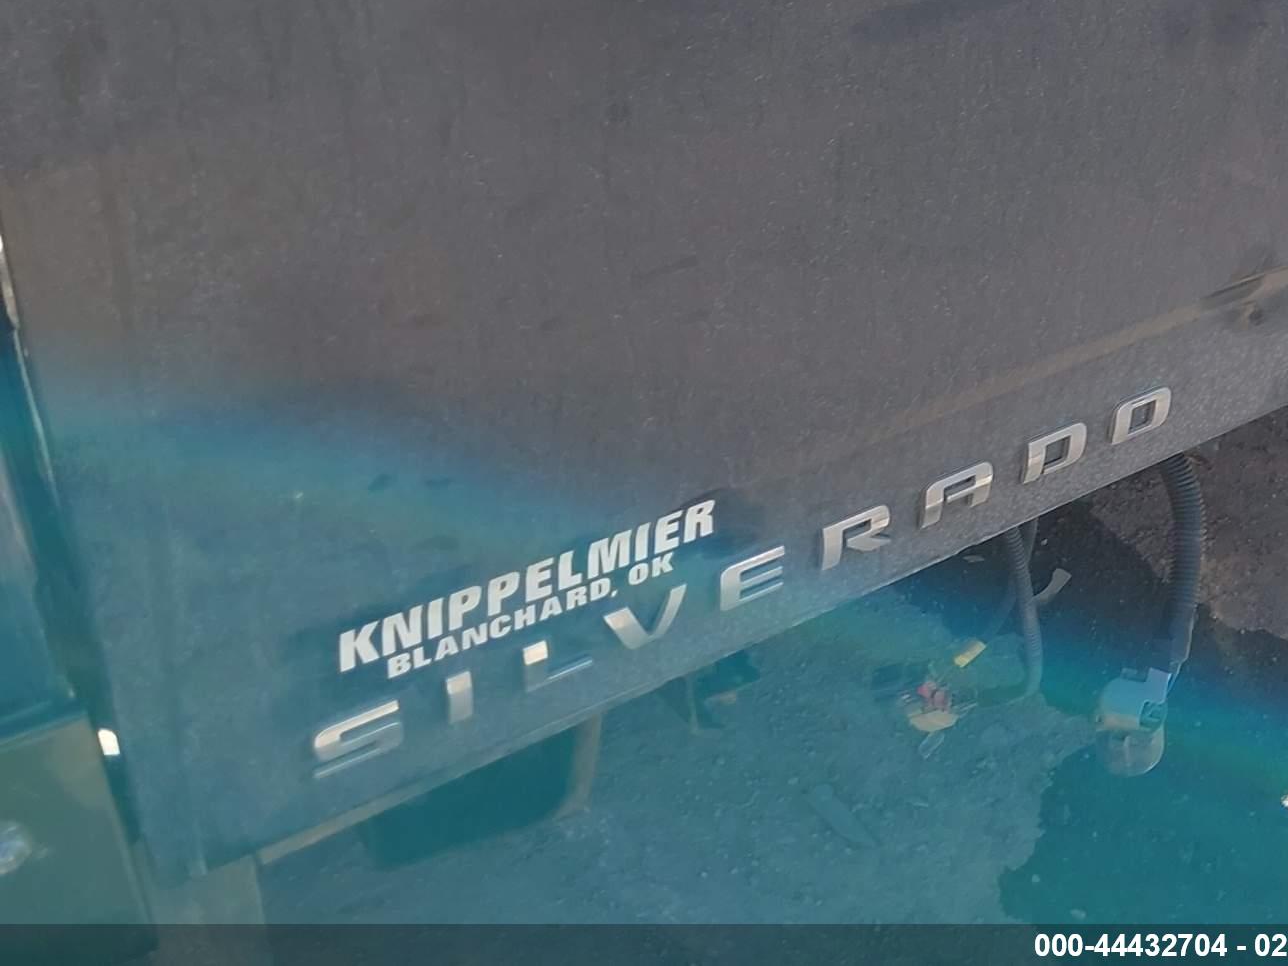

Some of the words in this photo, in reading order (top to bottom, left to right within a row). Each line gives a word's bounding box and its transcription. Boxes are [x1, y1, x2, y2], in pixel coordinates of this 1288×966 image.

[312, 385, 1173, 779] SILVERADO
[339, 499, 716, 673] KNIPPELMIER
[387, 575, 618, 679] BLANCHARD,
[627, 551, 675, 587] OK
